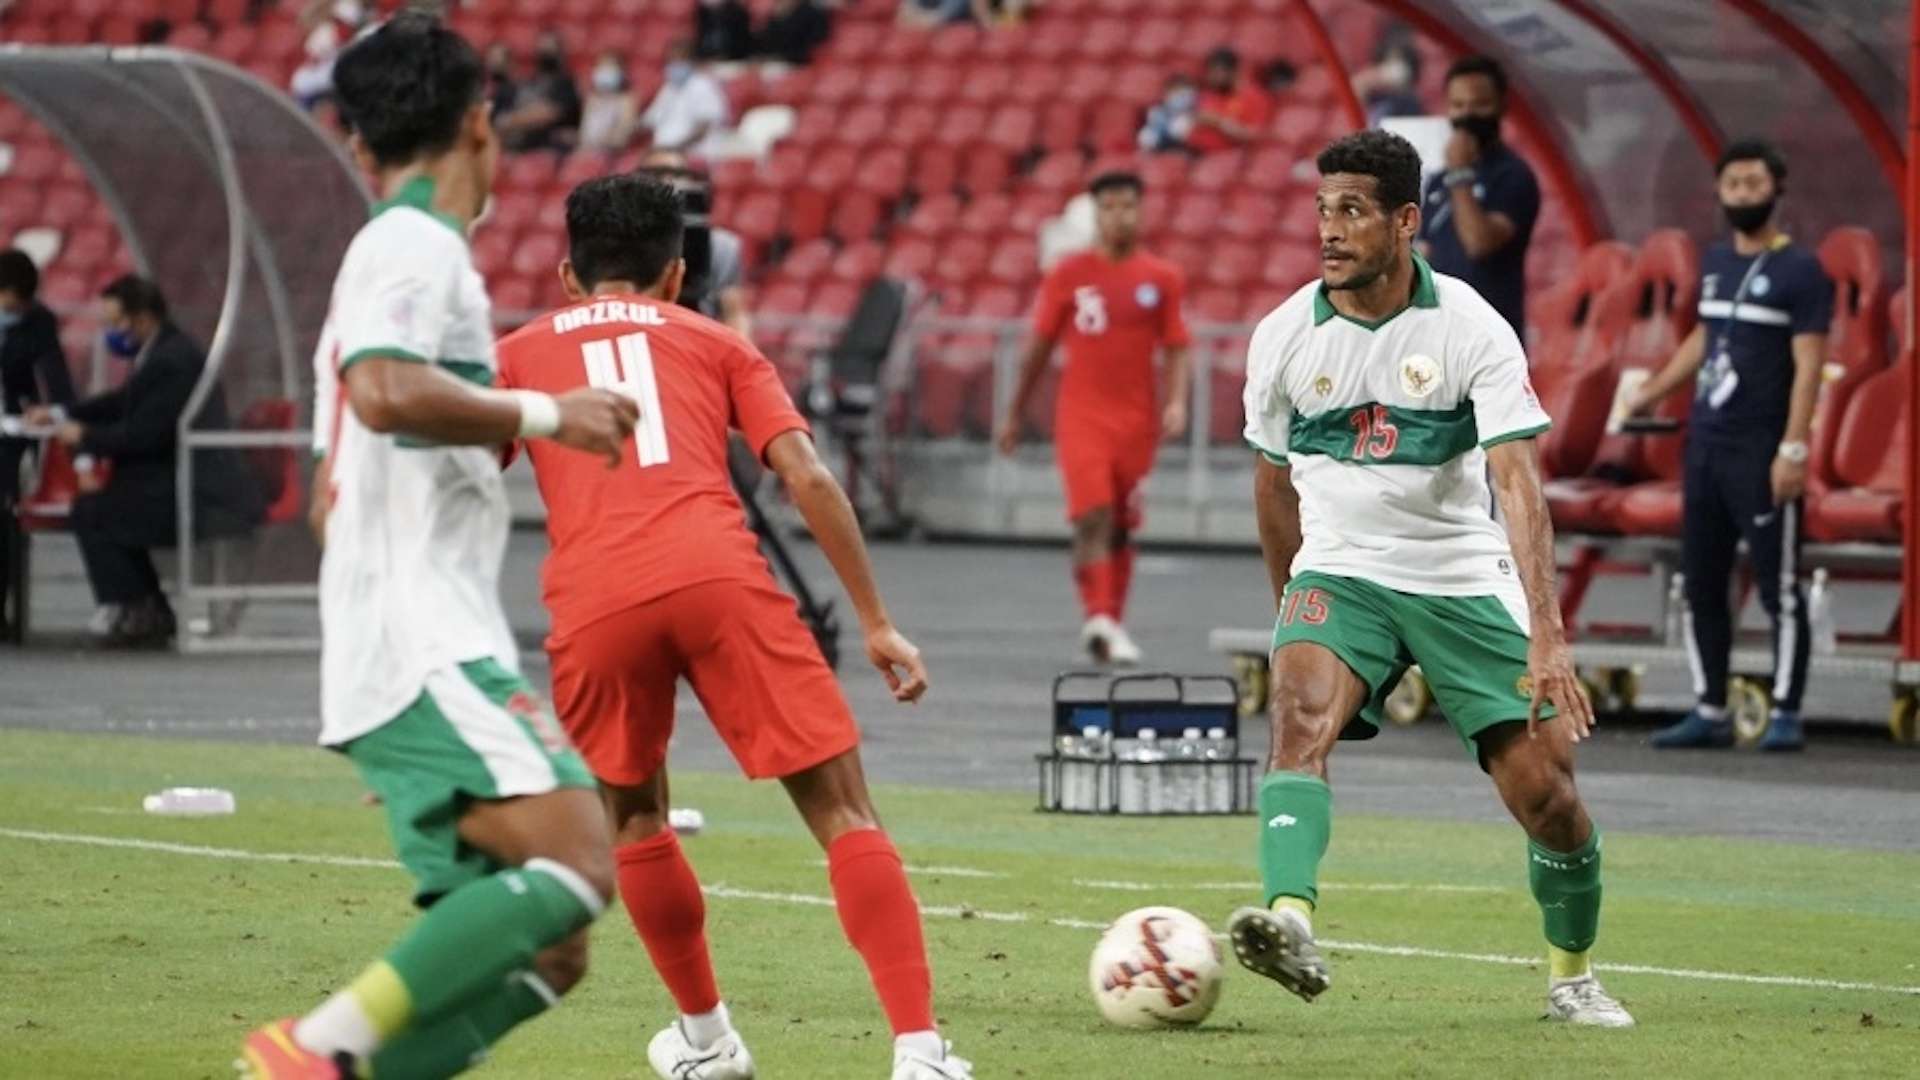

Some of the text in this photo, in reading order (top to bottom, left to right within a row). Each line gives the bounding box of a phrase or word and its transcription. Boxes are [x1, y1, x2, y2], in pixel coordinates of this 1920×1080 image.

[553, 300, 667, 334] NAZRUL
[581, 332, 670, 467] 4
[1351, 405, 1398, 459] 15
[1284, 588, 1330, 627] 15
